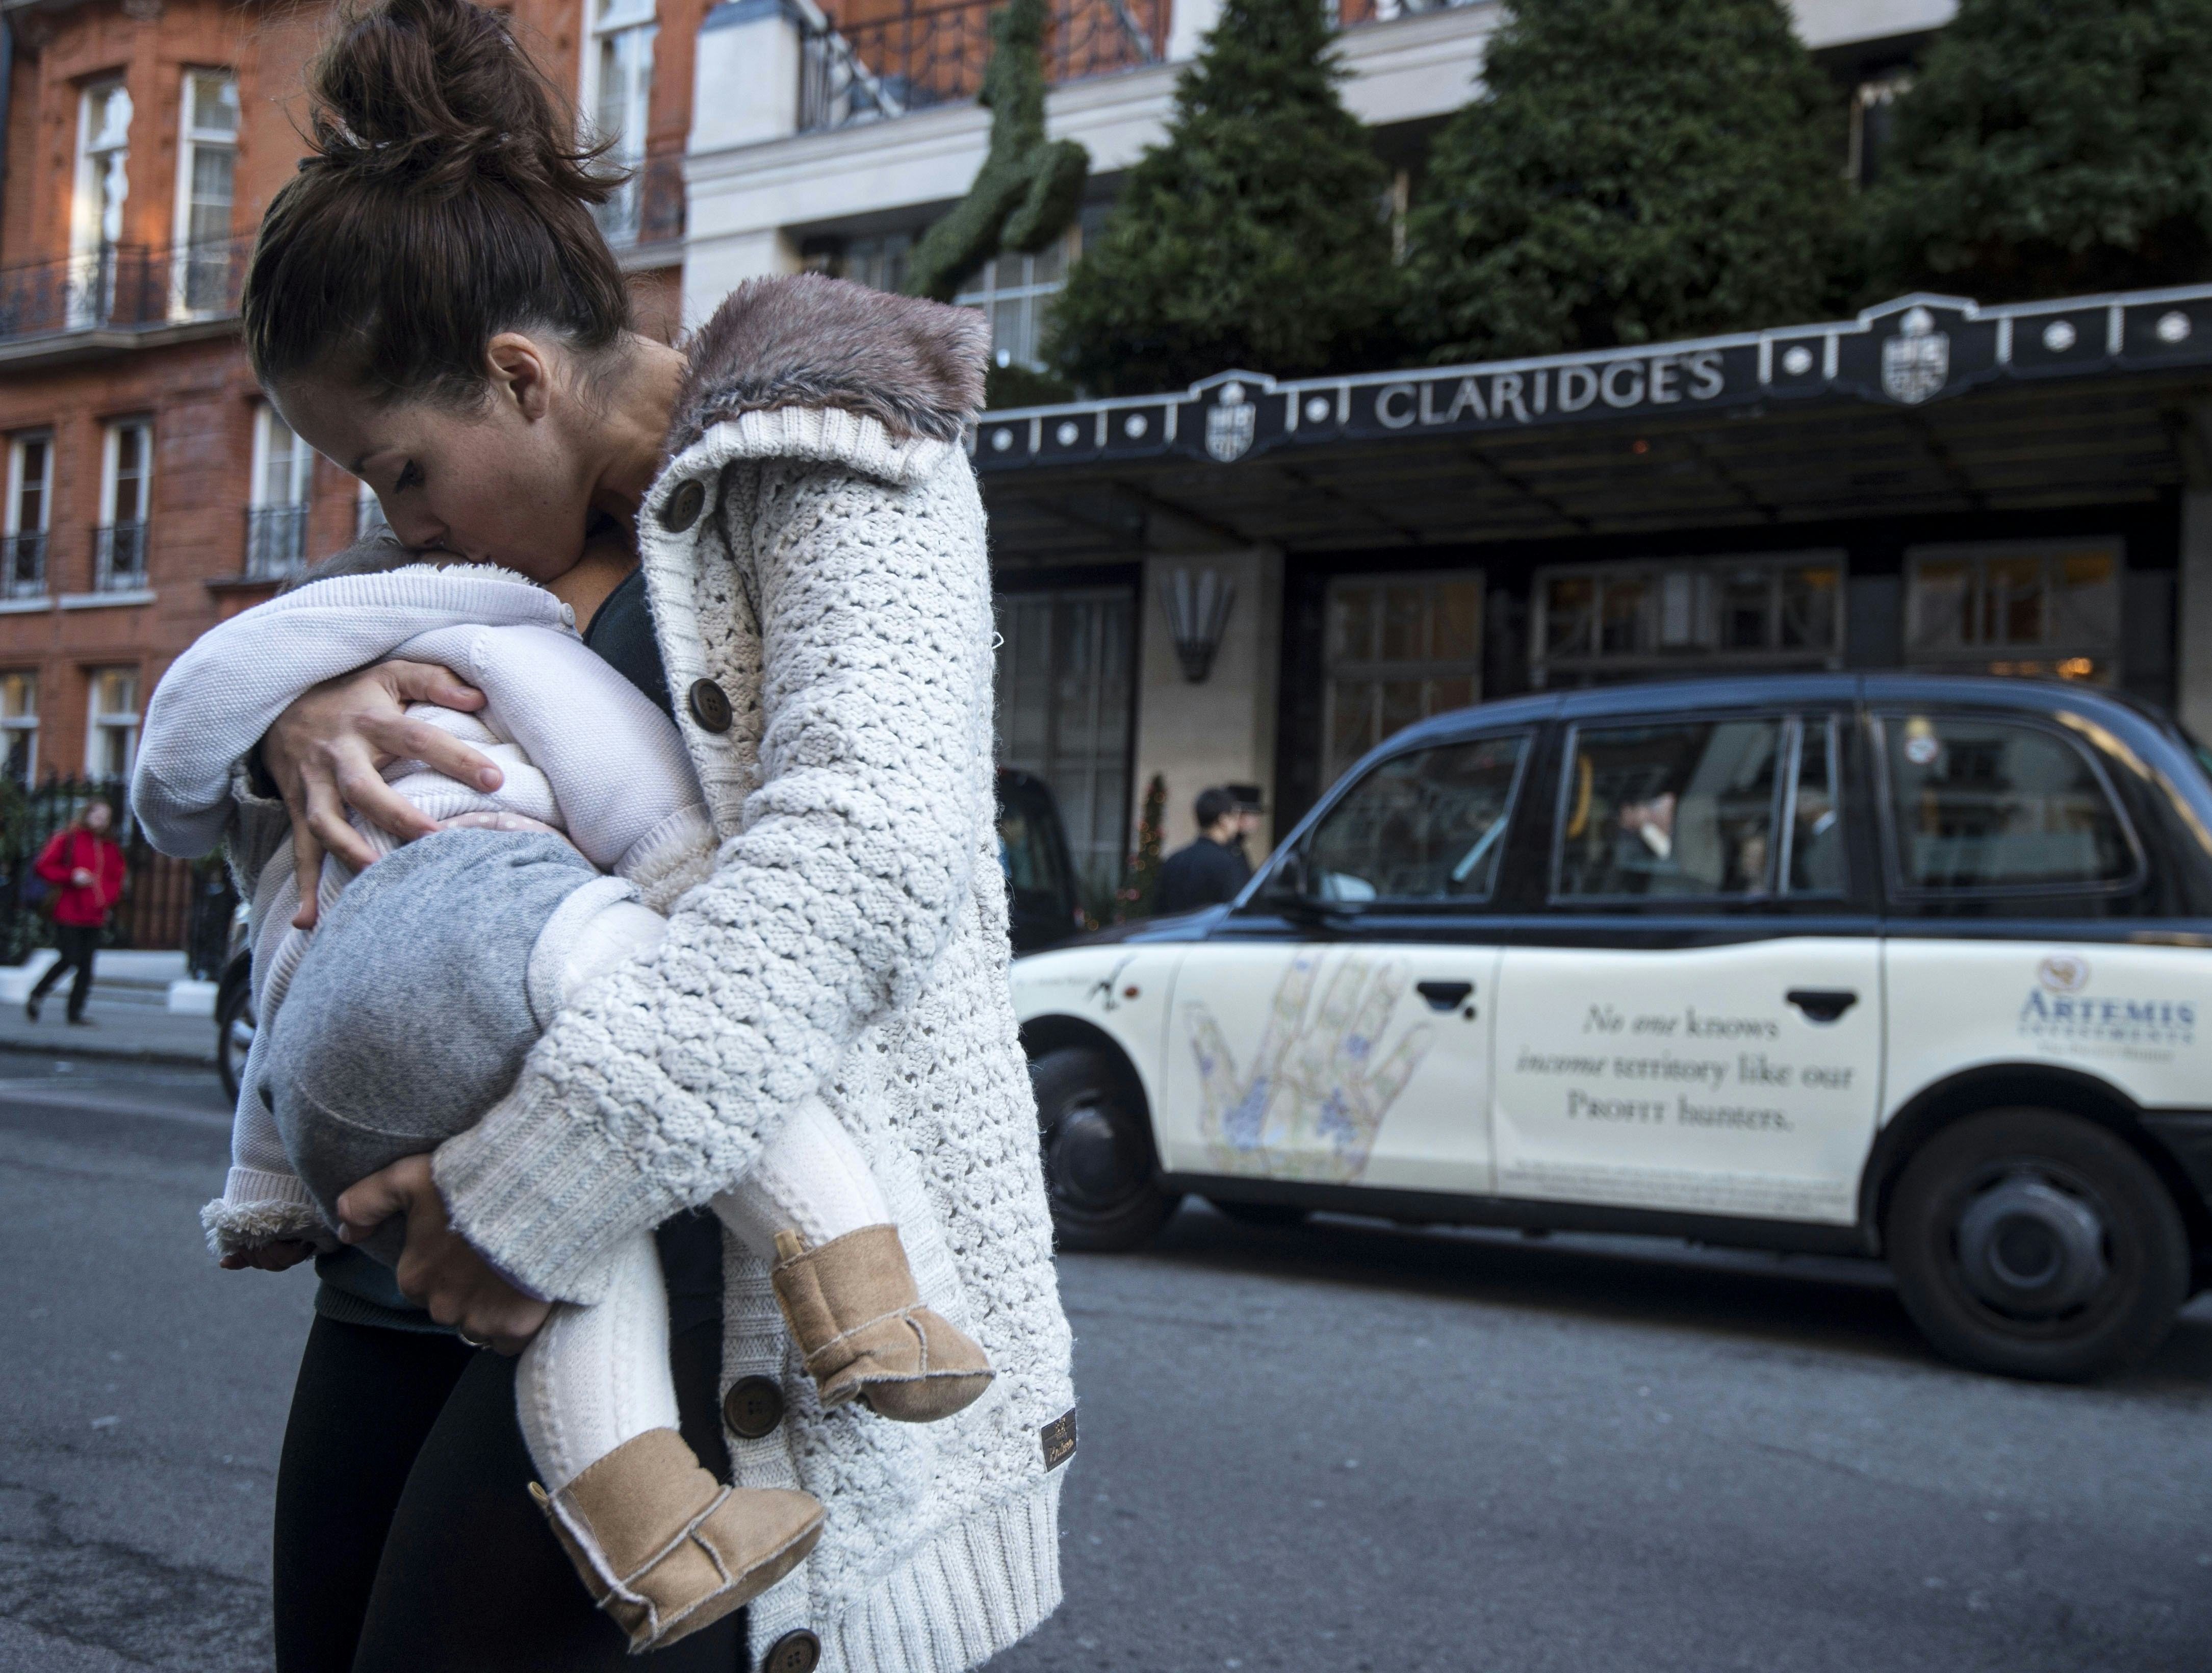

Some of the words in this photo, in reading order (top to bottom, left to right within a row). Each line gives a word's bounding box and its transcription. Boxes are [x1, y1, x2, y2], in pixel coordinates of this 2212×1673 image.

[1374, 350, 1725, 429] CLARIDGE'S
[1583, 1003, 1625, 1034] No
[1633, 1018, 1678, 1036] one
[1685, 1006, 1779, 1040] knows
[1515, 1046, 1607, 1077] income
[1613, 1049, 1730, 1092] territory
[1738, 1051, 1791, 1087] like
[1801, 1065, 1855, 1089] our
[1678, 1093, 1794, 1131] hunters.
